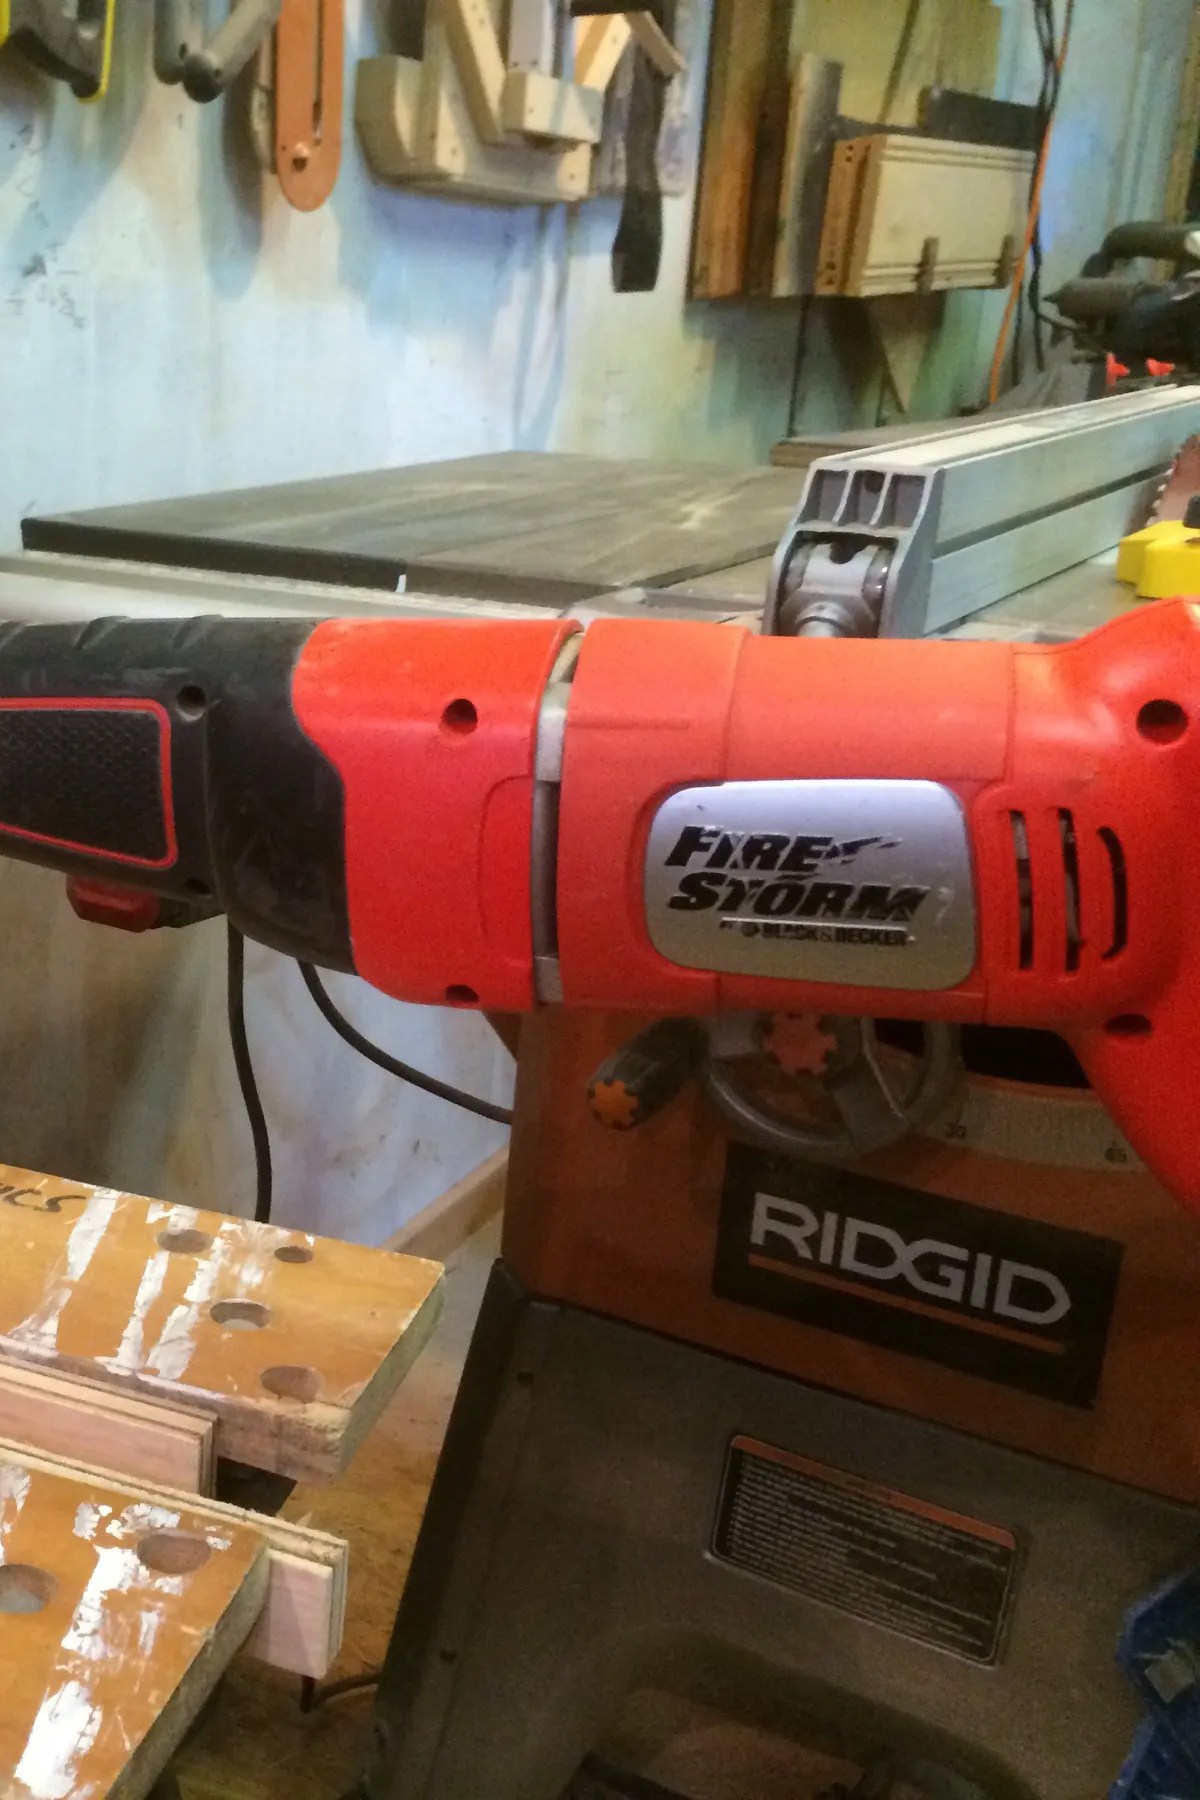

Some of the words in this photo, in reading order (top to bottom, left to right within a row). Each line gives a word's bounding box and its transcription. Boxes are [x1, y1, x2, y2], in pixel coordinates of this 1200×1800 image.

[664, 825, 834, 872] FIRE
[666, 871, 930, 922] STORM
[749, 1191, 1072, 1325] RIDGID
